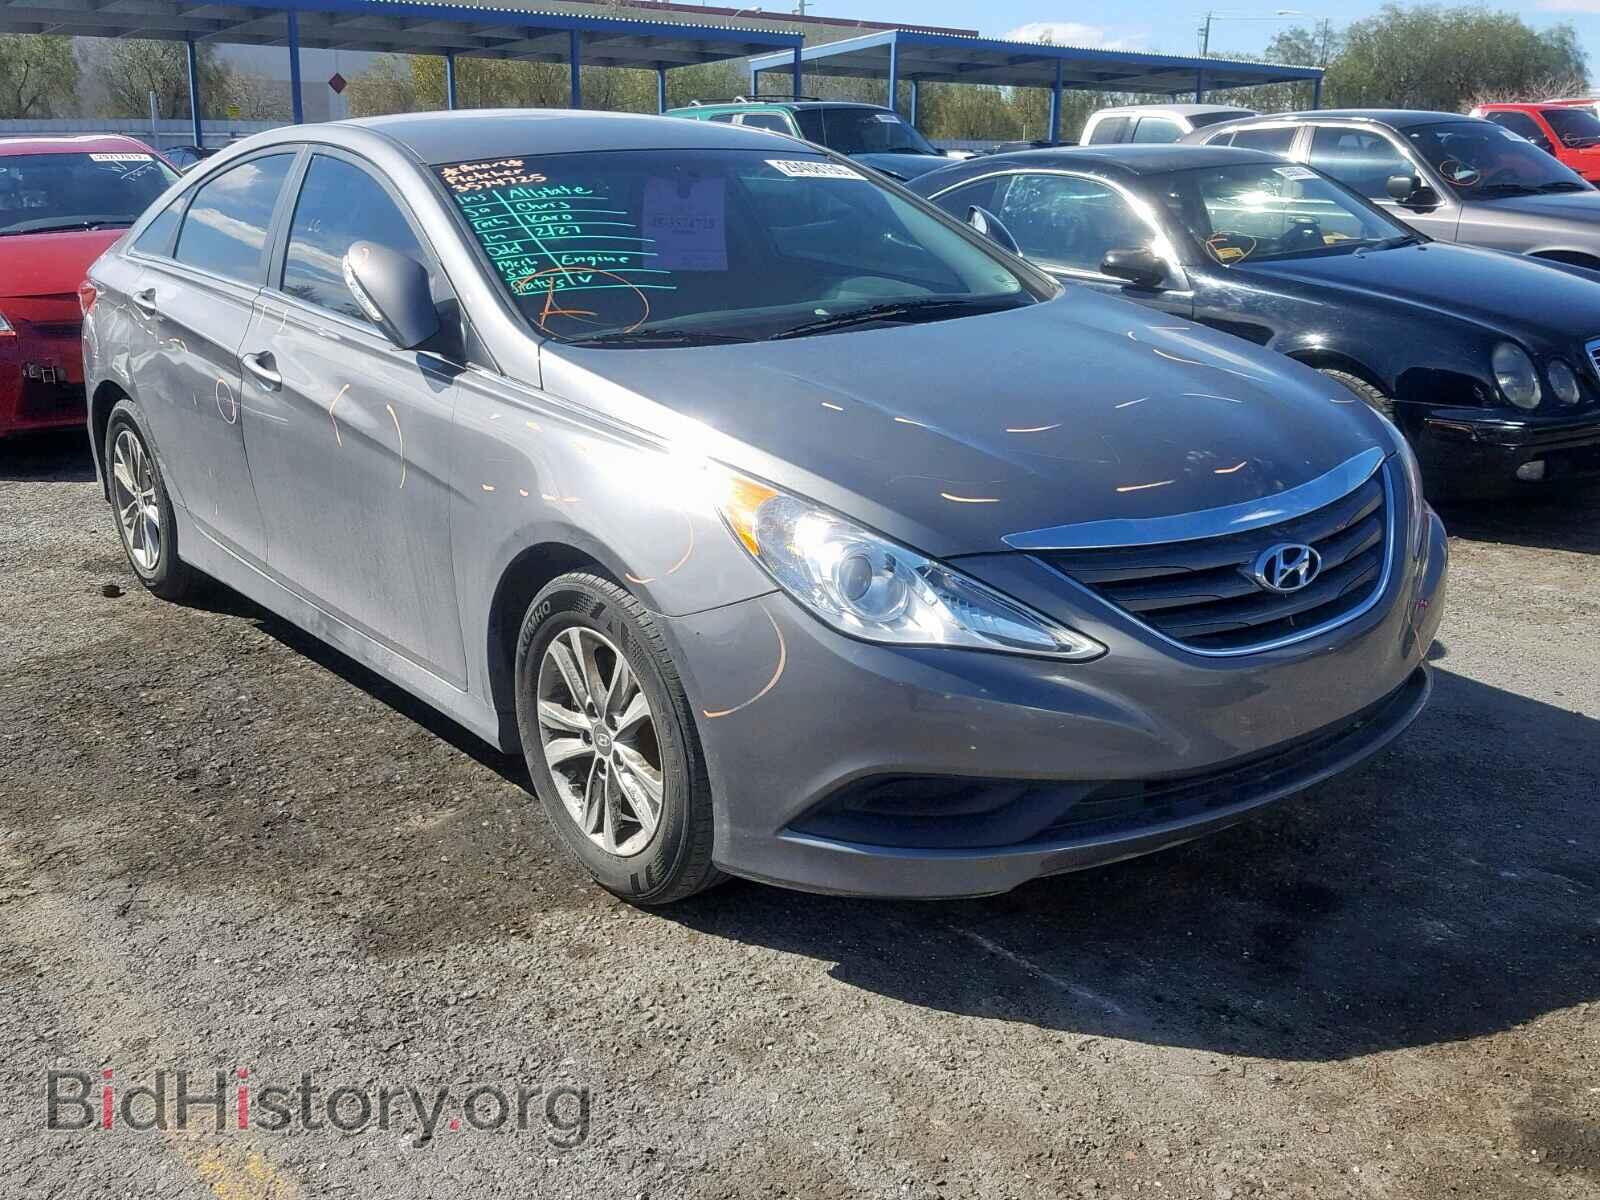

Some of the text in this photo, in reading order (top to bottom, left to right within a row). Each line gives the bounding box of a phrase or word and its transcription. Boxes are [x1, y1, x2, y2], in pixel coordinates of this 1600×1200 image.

[509, 185, 593, 199] Allstate
[515, 201, 571, 212] Chris
[535, 224, 581, 237] 2/27
[561, 254, 630, 267] Engine
